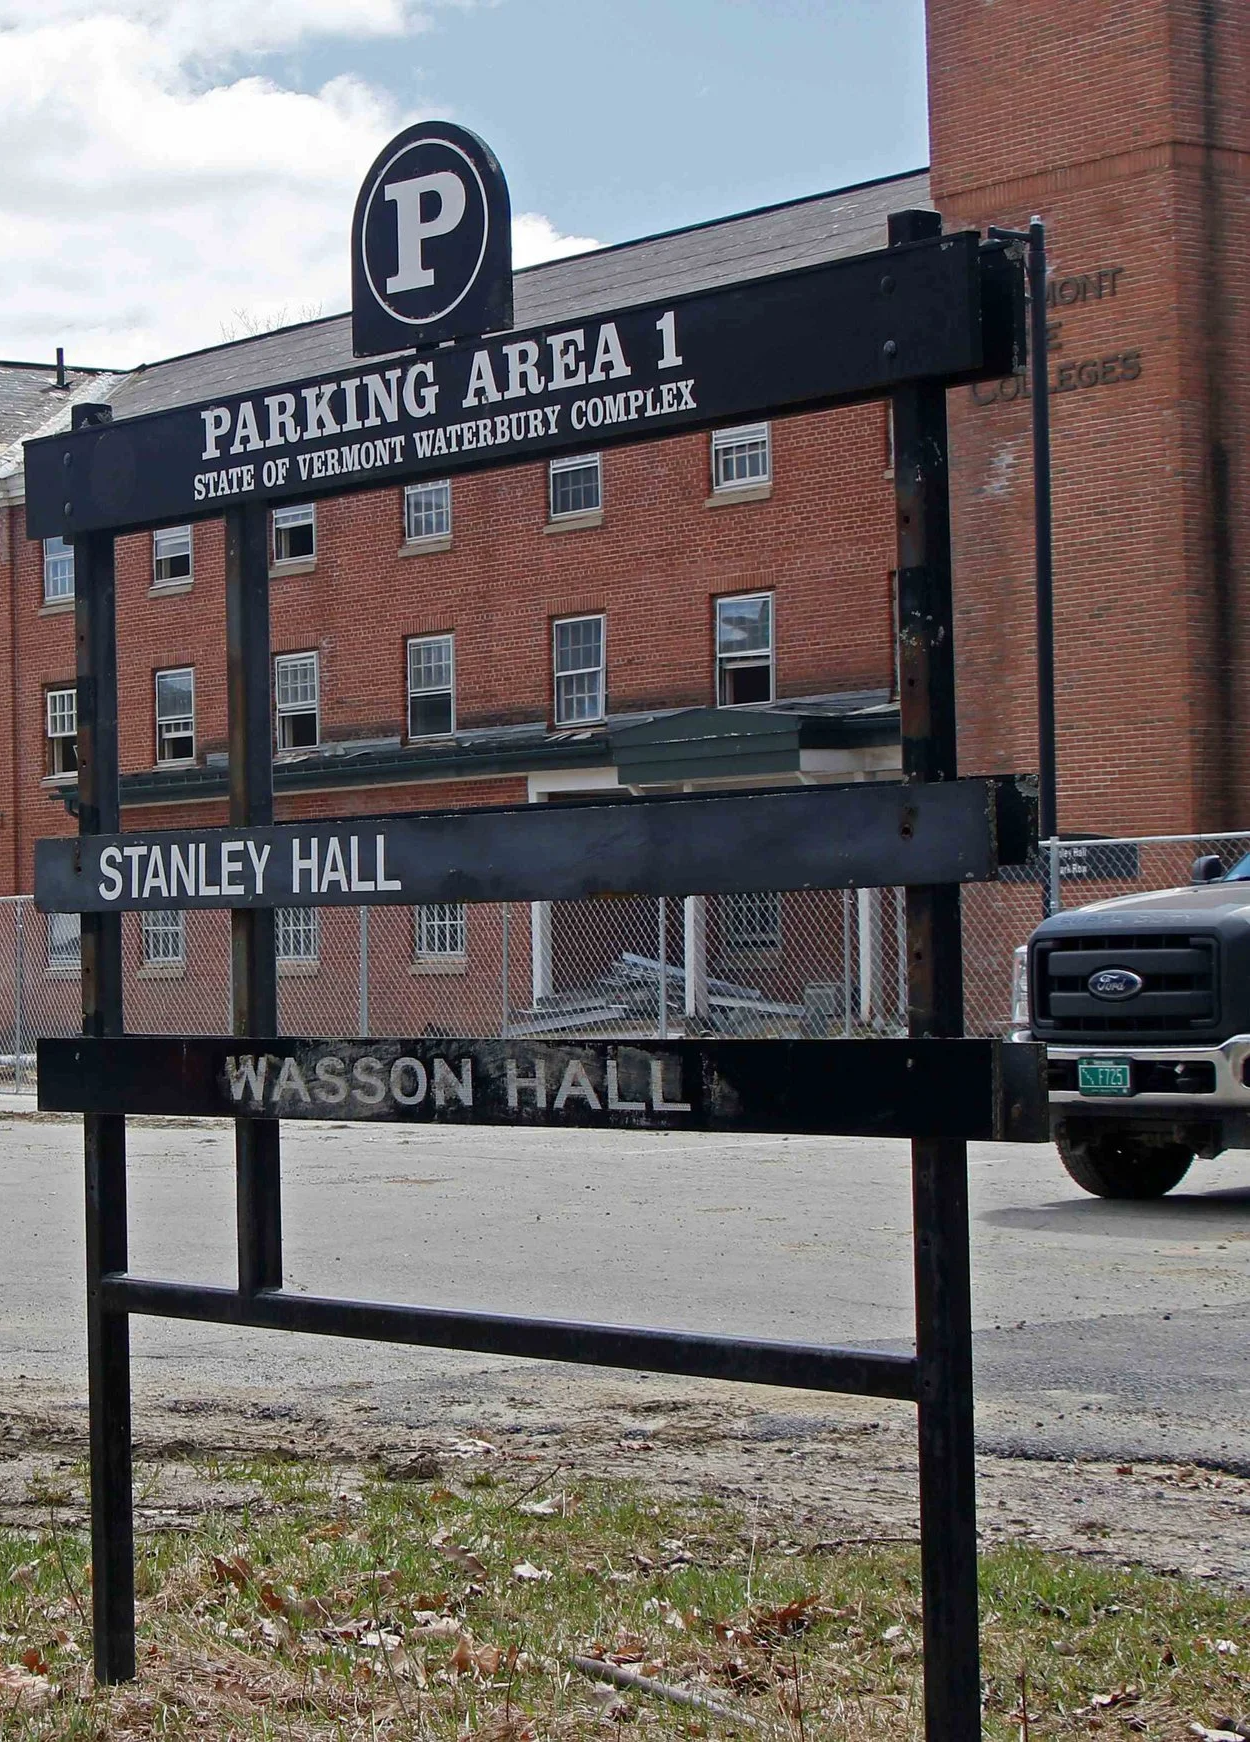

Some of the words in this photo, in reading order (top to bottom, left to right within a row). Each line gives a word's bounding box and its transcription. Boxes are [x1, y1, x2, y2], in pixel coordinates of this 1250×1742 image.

[384, 171, 466, 294] P
[1046, 267, 1125, 308] ONT
[201, 361, 439, 460] PARKING
[462, 322, 631, 408] AREA
[656, 311, 683, 370] 1
[194, 464, 255, 500] STATE
[262, 457, 289, 487] OF
[297, 435, 404, 481] VERMONT
[413, 405, 561, 458] WATERBURY
[571, 379, 696, 430] COMPLEX
[98, 840, 271, 900] STANLEY
[291, 834, 401, 894] HALL
[1097, 974, 1126, 992] Ford
[225, 1053, 473, 1107] WASSON
[507, 1058, 692, 1112] HALL
